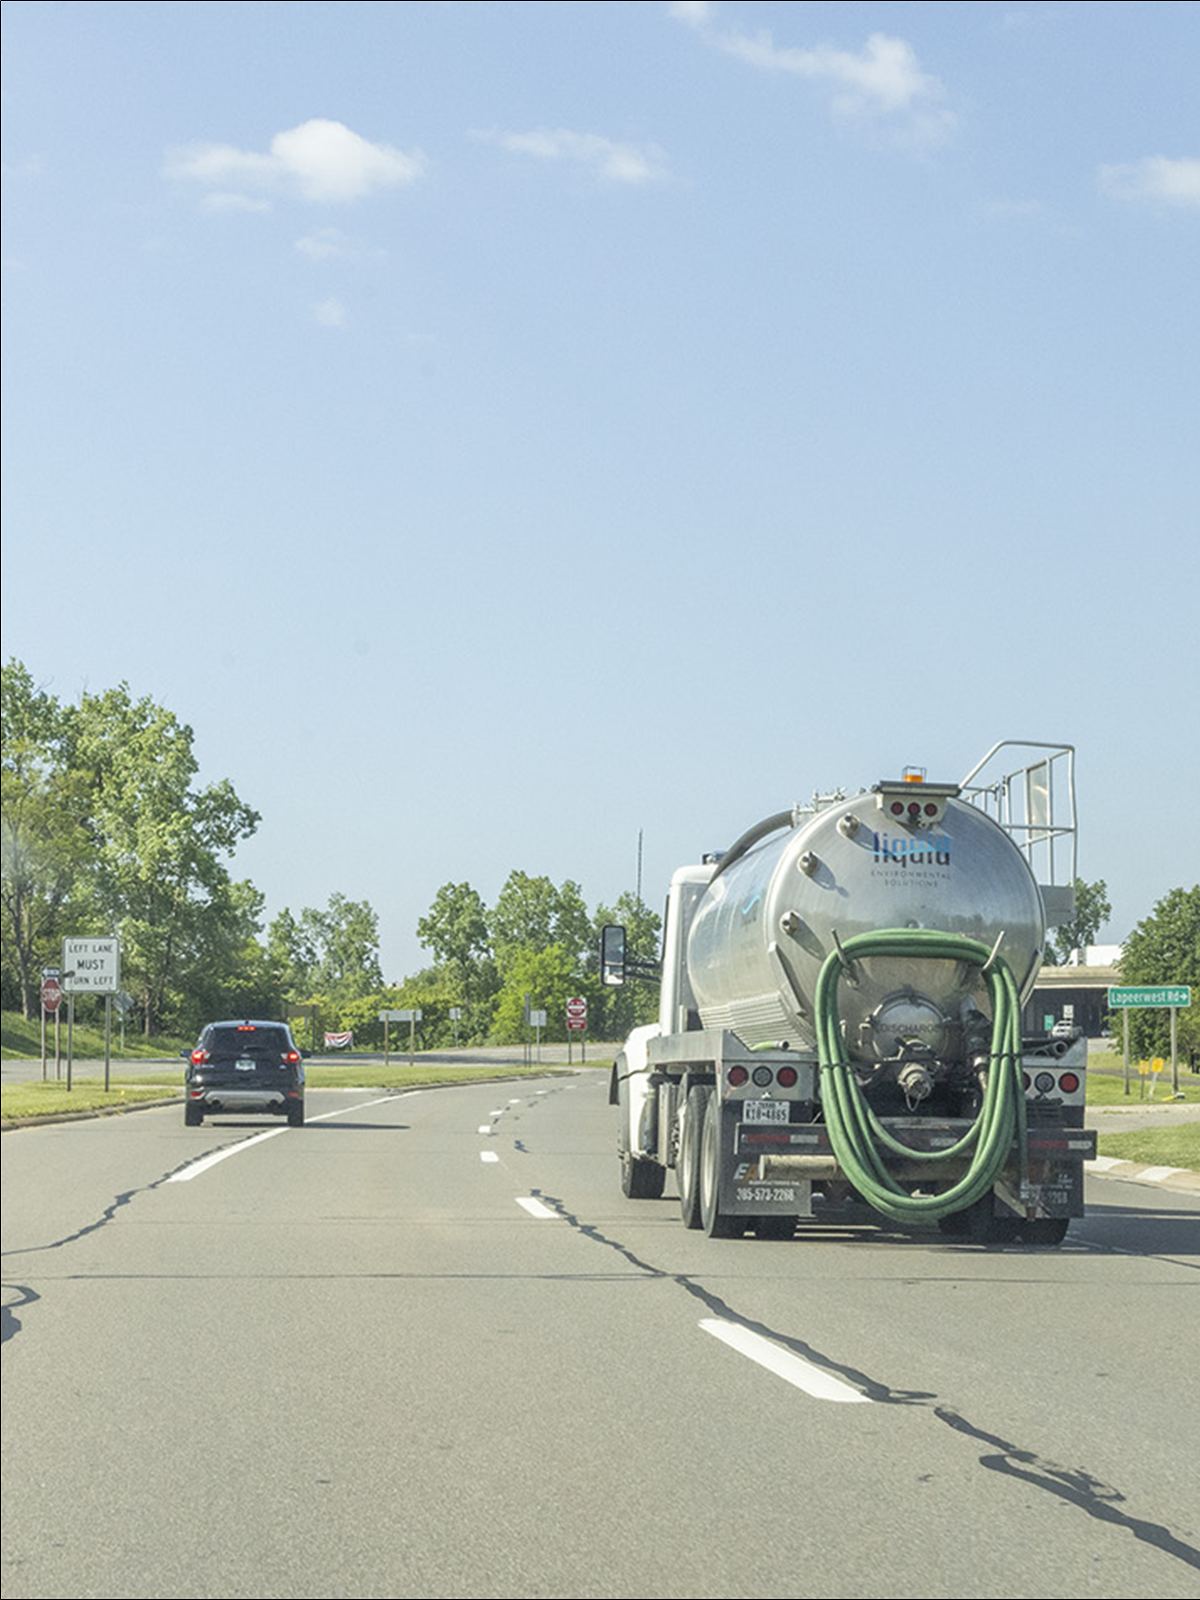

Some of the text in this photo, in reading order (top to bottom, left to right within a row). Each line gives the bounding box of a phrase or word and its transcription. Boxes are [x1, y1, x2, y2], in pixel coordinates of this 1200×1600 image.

[874, 832, 950, 868] liquid
[871, 870, 952, 880] ENVIRONMENTAL
[69, 944, 113, 953] LEFT LANE
[77, 959, 105, 970] MUST
[94, 976, 114, 985] LEFT
[43, 988, 61, 1001] STOP
[1111, 991, 1180, 1005] Lapeerwest Rd
